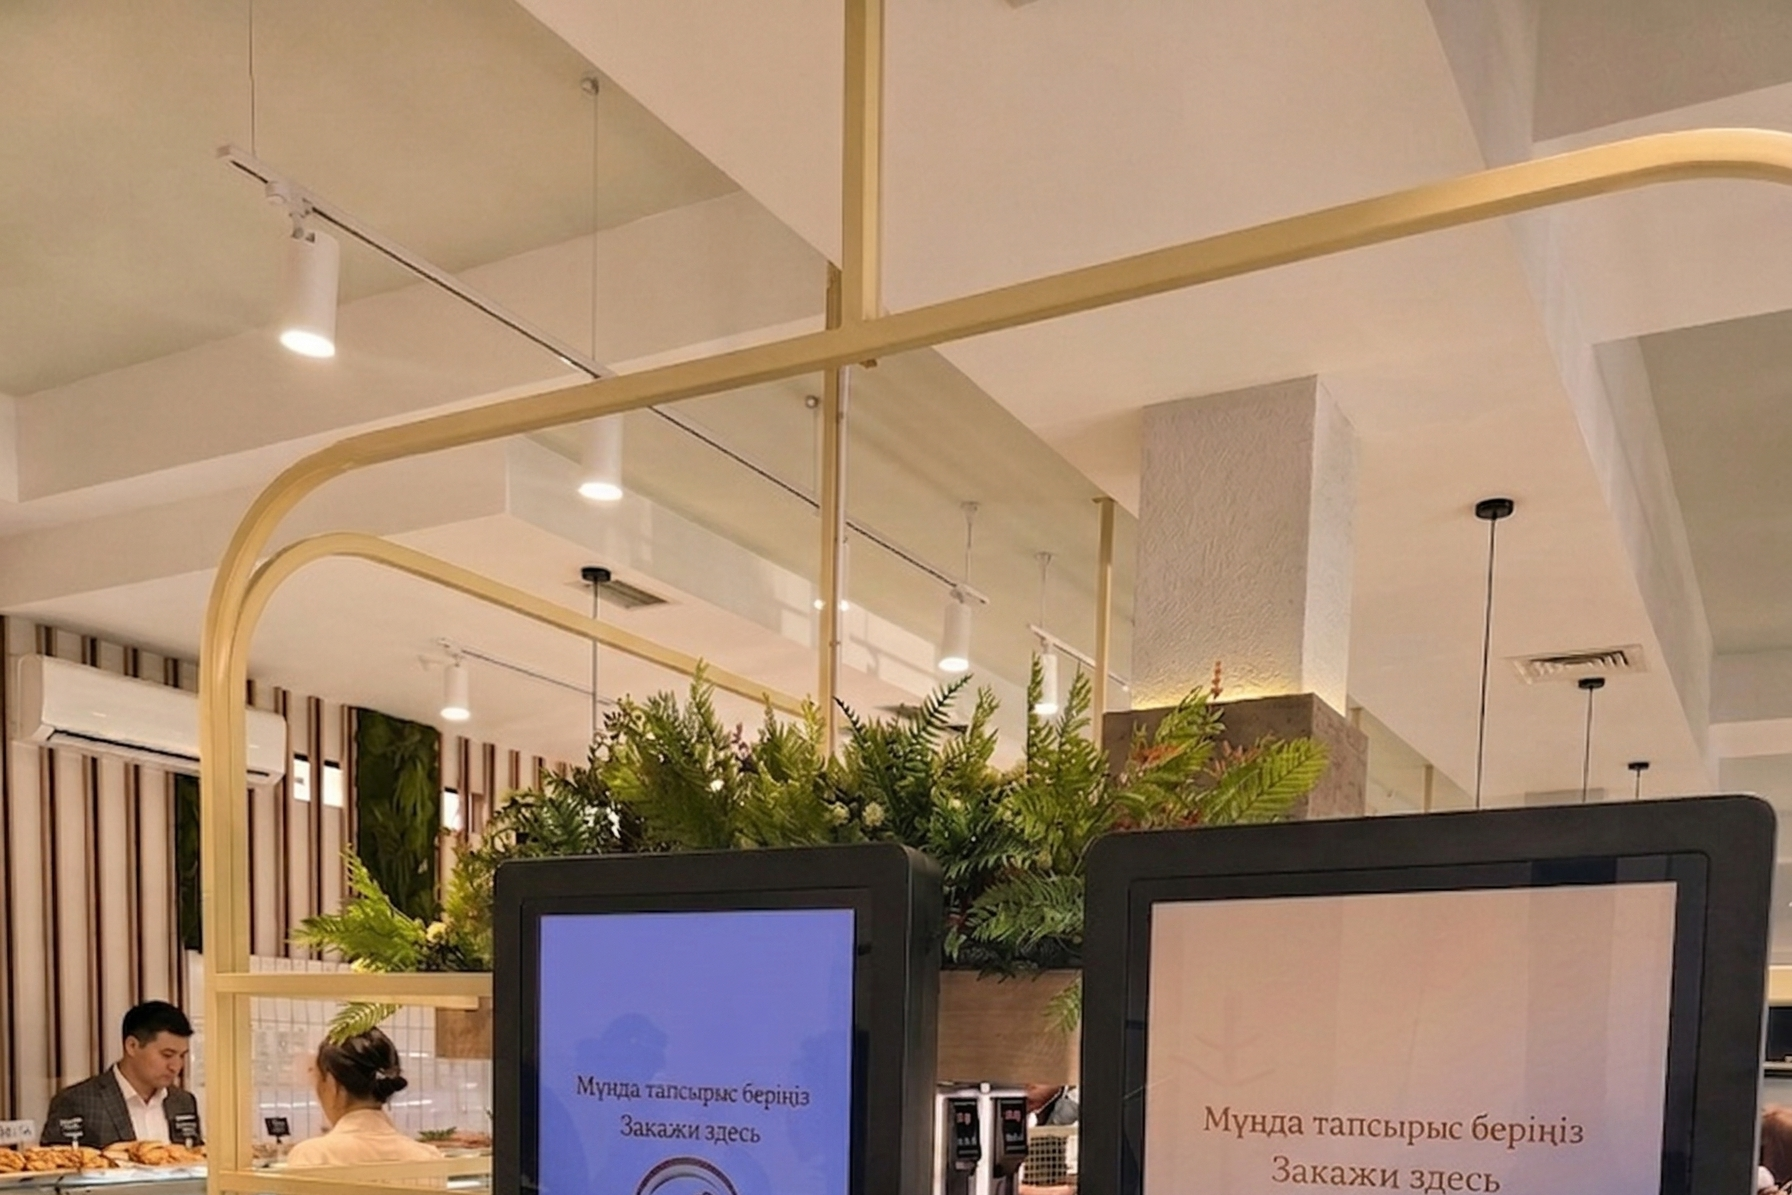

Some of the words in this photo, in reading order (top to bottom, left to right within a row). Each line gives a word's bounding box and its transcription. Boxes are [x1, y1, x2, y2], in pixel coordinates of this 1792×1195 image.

[645, 1084, 738, 1108] тапсырыс
[742, 1082, 810, 1110] беріңіз
[620, 1113, 701, 1141] Закажи
[704, 1124, 761, 1146] здесь
[1312, 1115, 1464, 1147] тапсырыс
[1471, 1112, 1584, 1150] беріңіз
[1271, 1155, 1400, 1190] Закажи
[1409, 1169, 1501, 1195] здесь
